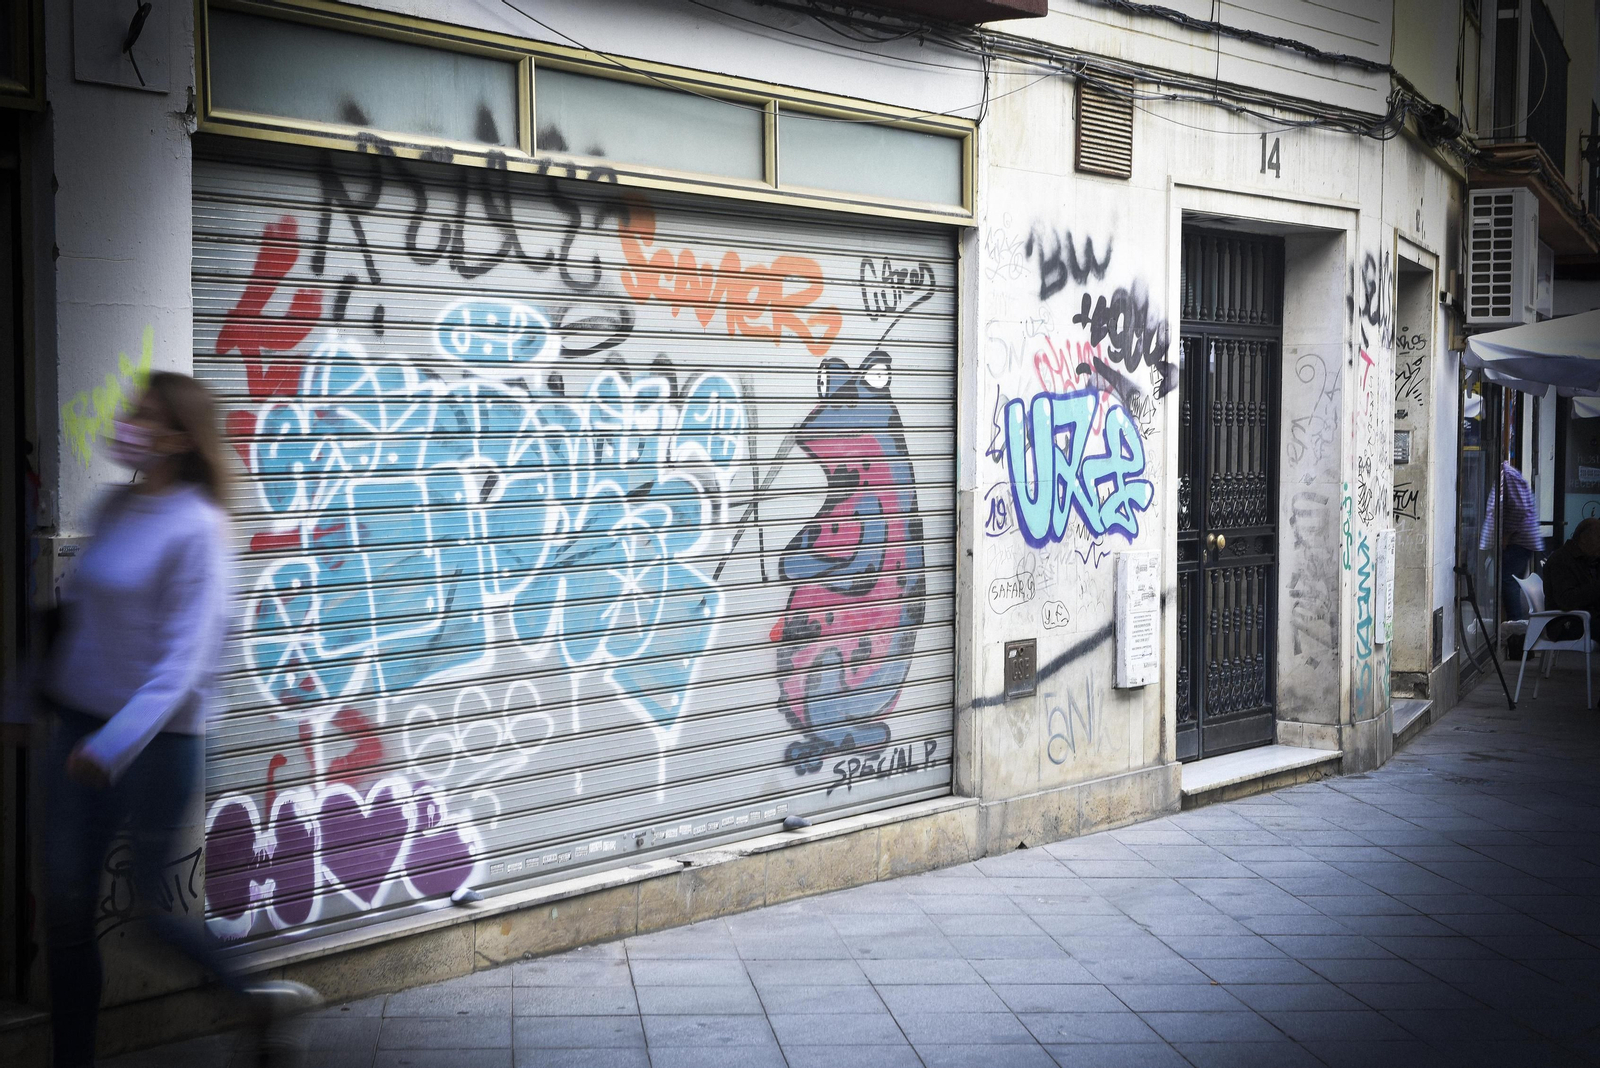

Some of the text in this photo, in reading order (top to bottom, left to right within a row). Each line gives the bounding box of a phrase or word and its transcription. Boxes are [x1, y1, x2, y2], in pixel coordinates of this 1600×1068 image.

[1259, 132, 1281, 179] 14
[403, 679, 554, 781] 666
[826, 744, 919, 796] SPECIAL
